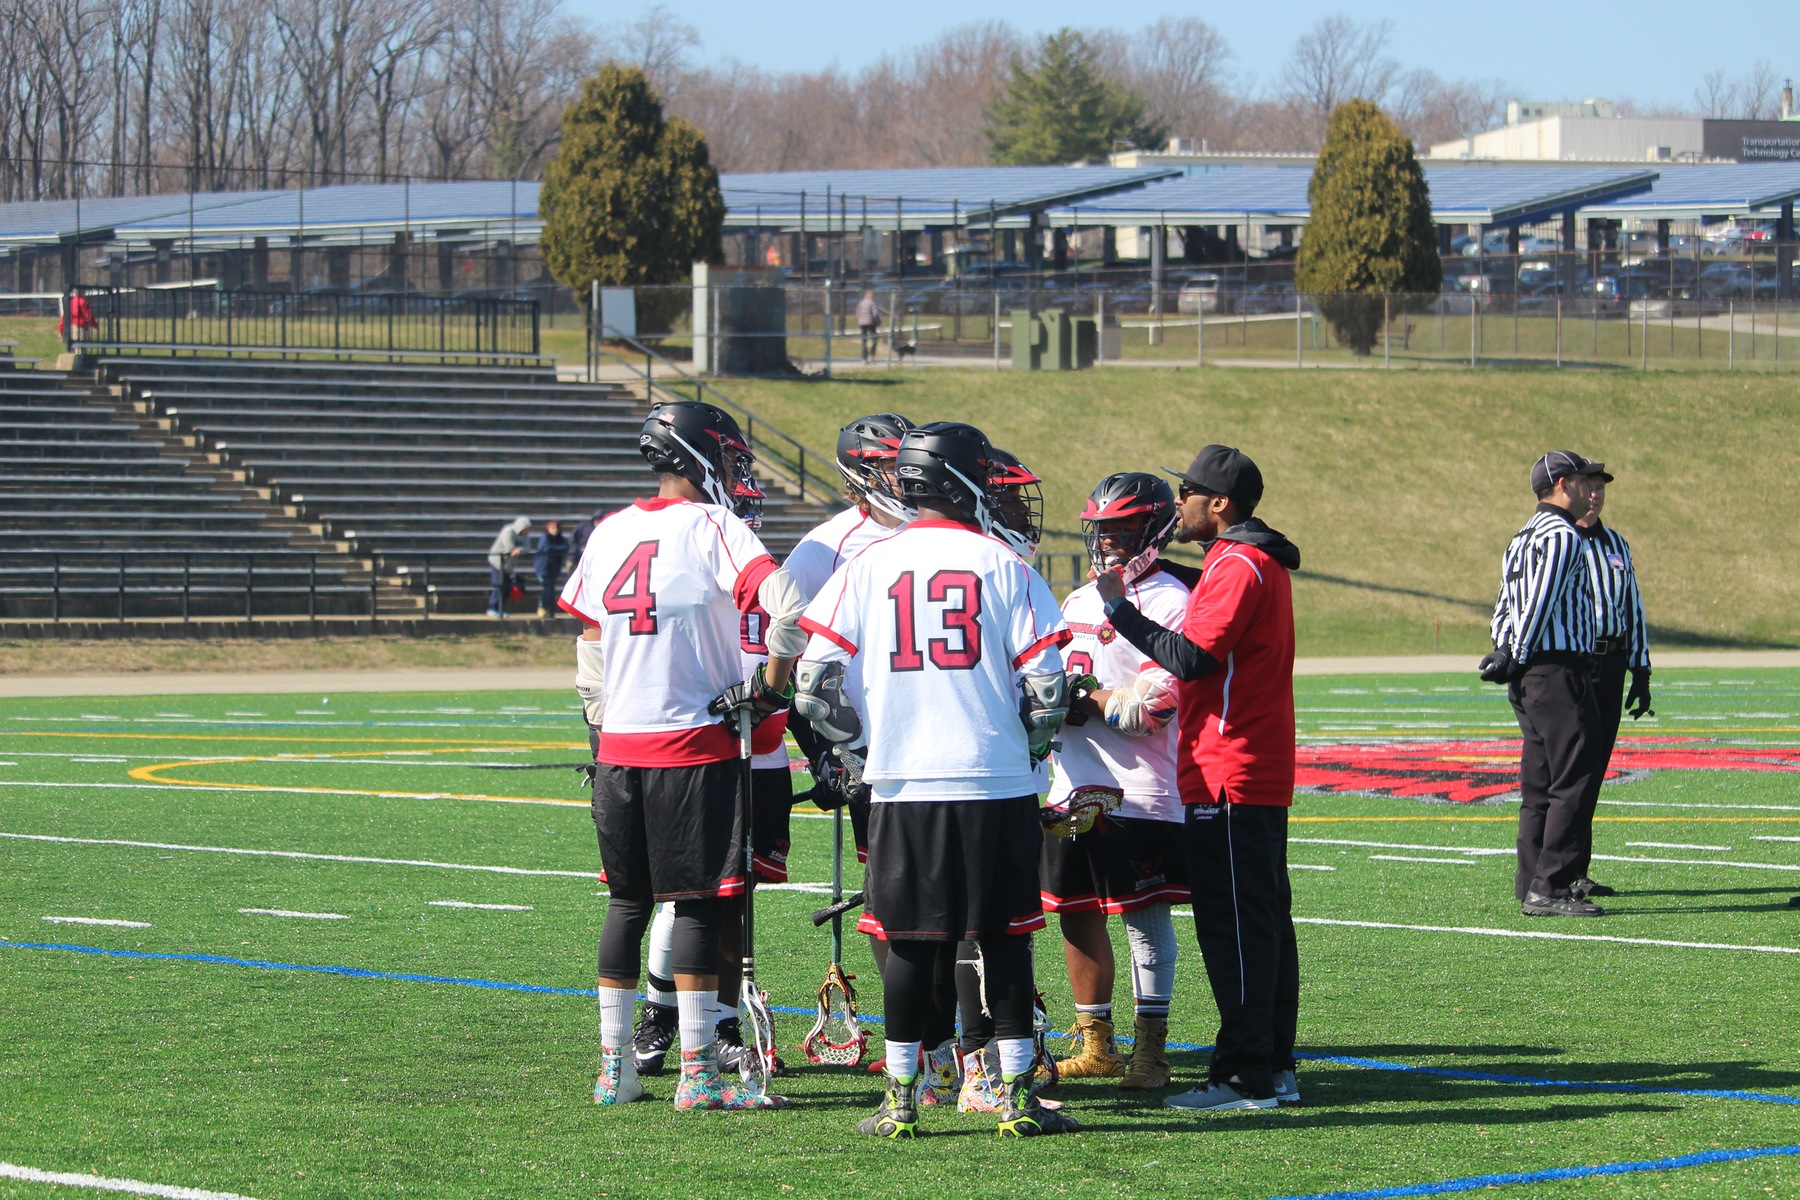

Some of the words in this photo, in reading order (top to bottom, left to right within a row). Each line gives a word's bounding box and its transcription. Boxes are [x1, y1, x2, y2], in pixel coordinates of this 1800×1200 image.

[1742, 148, 1789, 158] Technology
[603, 540, 660, 635] 4
[888, 570, 983, 672] 13
